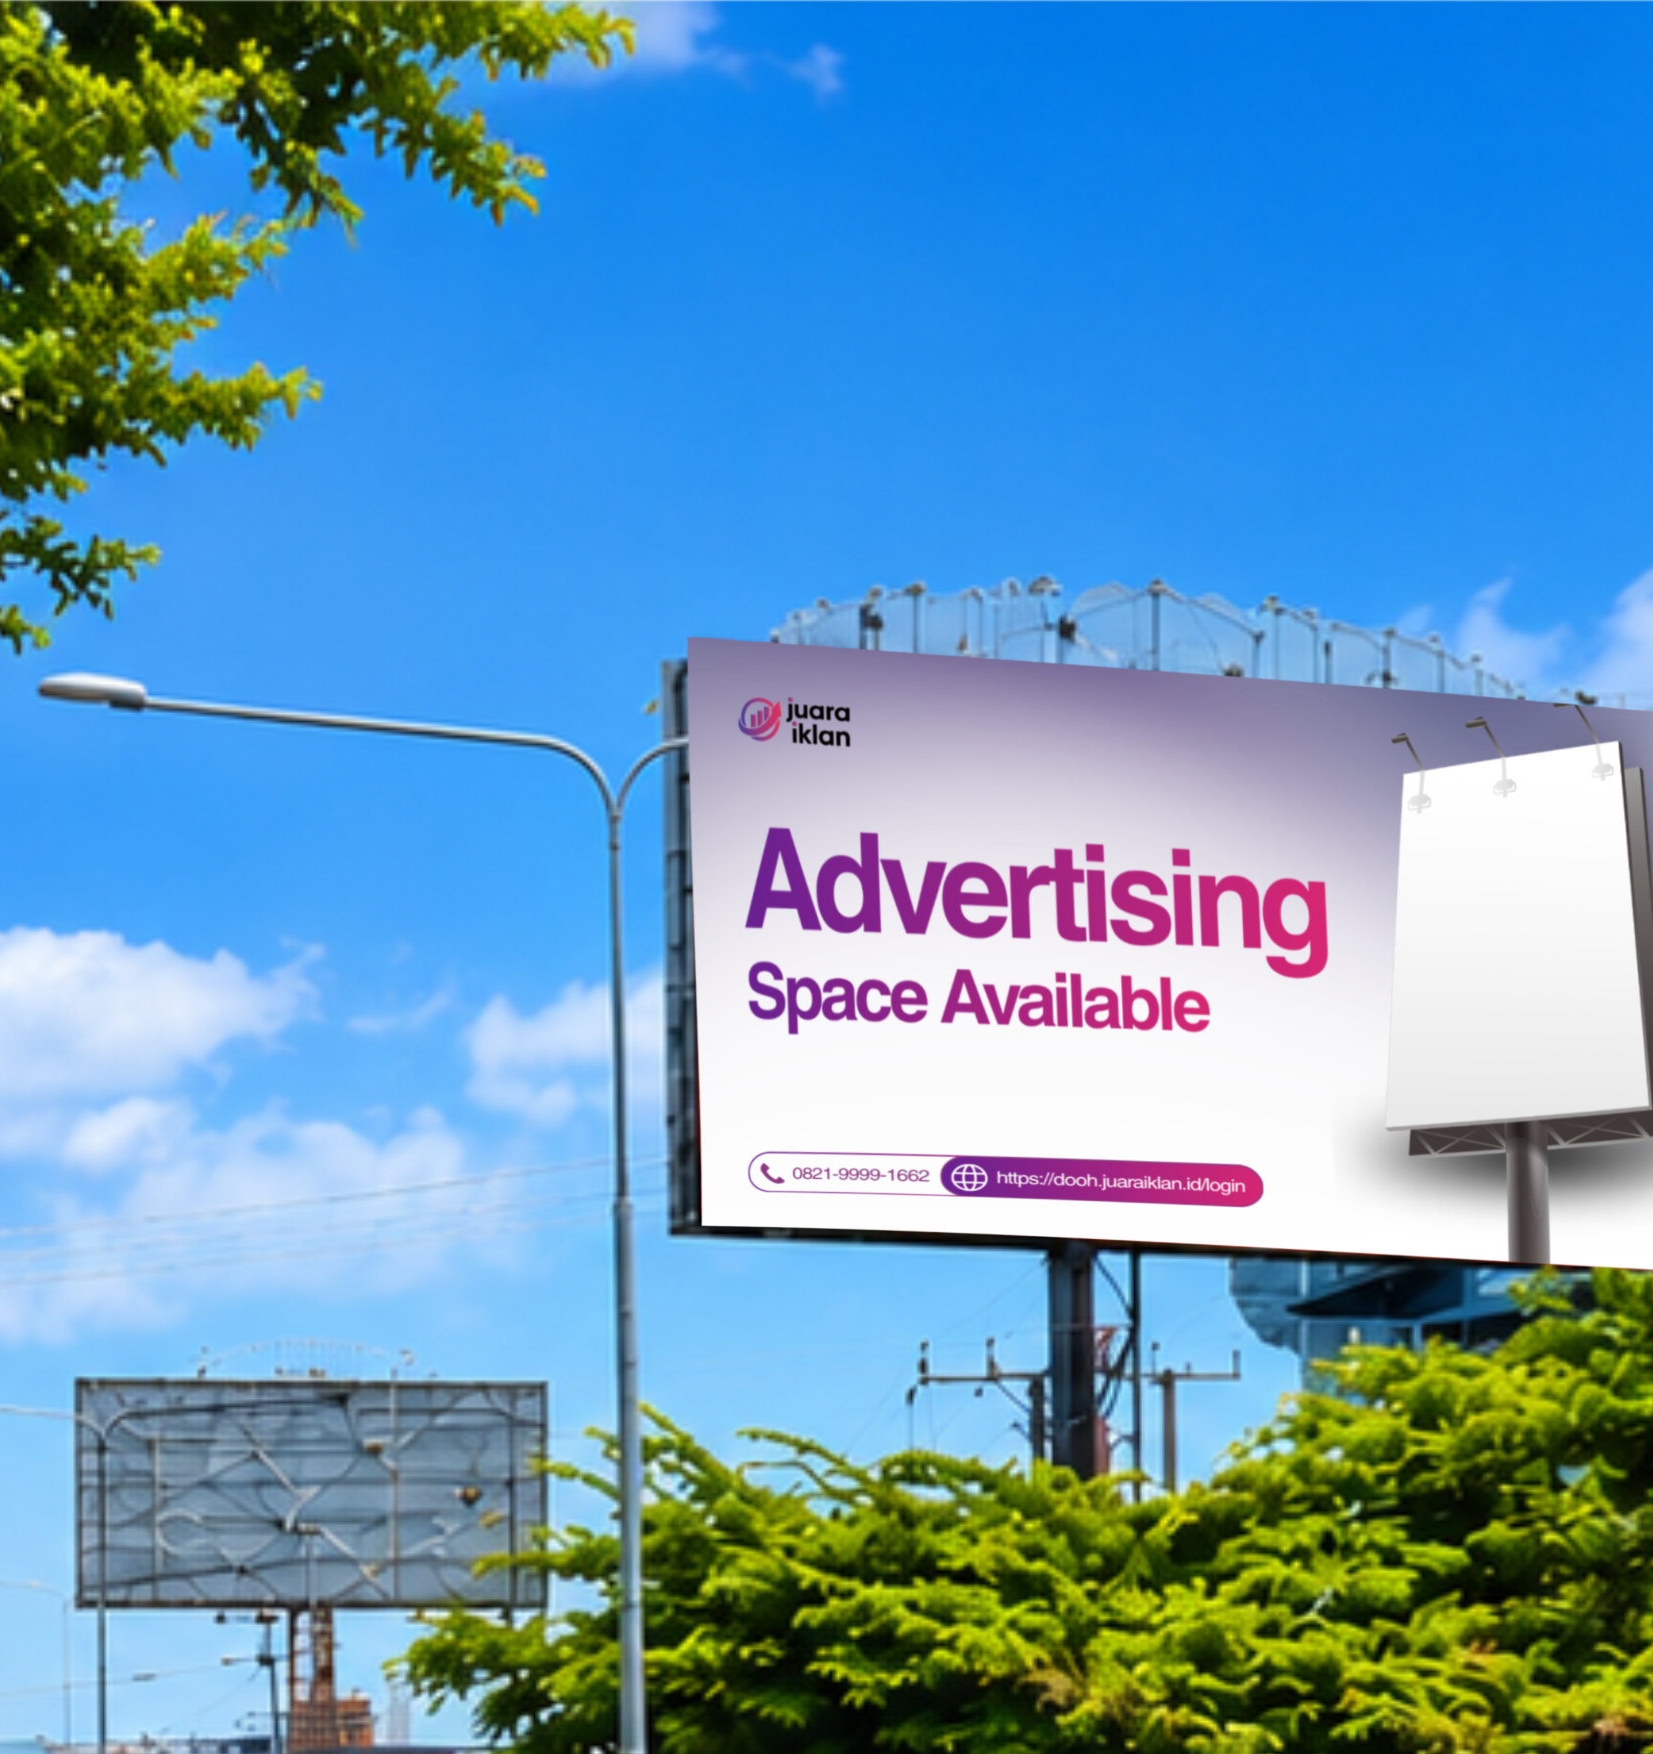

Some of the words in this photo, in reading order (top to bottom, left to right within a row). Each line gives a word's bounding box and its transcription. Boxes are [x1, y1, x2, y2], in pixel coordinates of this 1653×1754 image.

[786, 697, 851, 723] juara
[792, 721, 851, 747] iklan
[745, 827, 1329, 979] Advertising
[747, 961, 929, 1035] Space
[940, 968, 1211, 1033] Available
[792, 1166, 930, 1183] 0821-9999-1662
[996, 1170, 1246, 1196] https://dooh.juaraiklan.id/login
